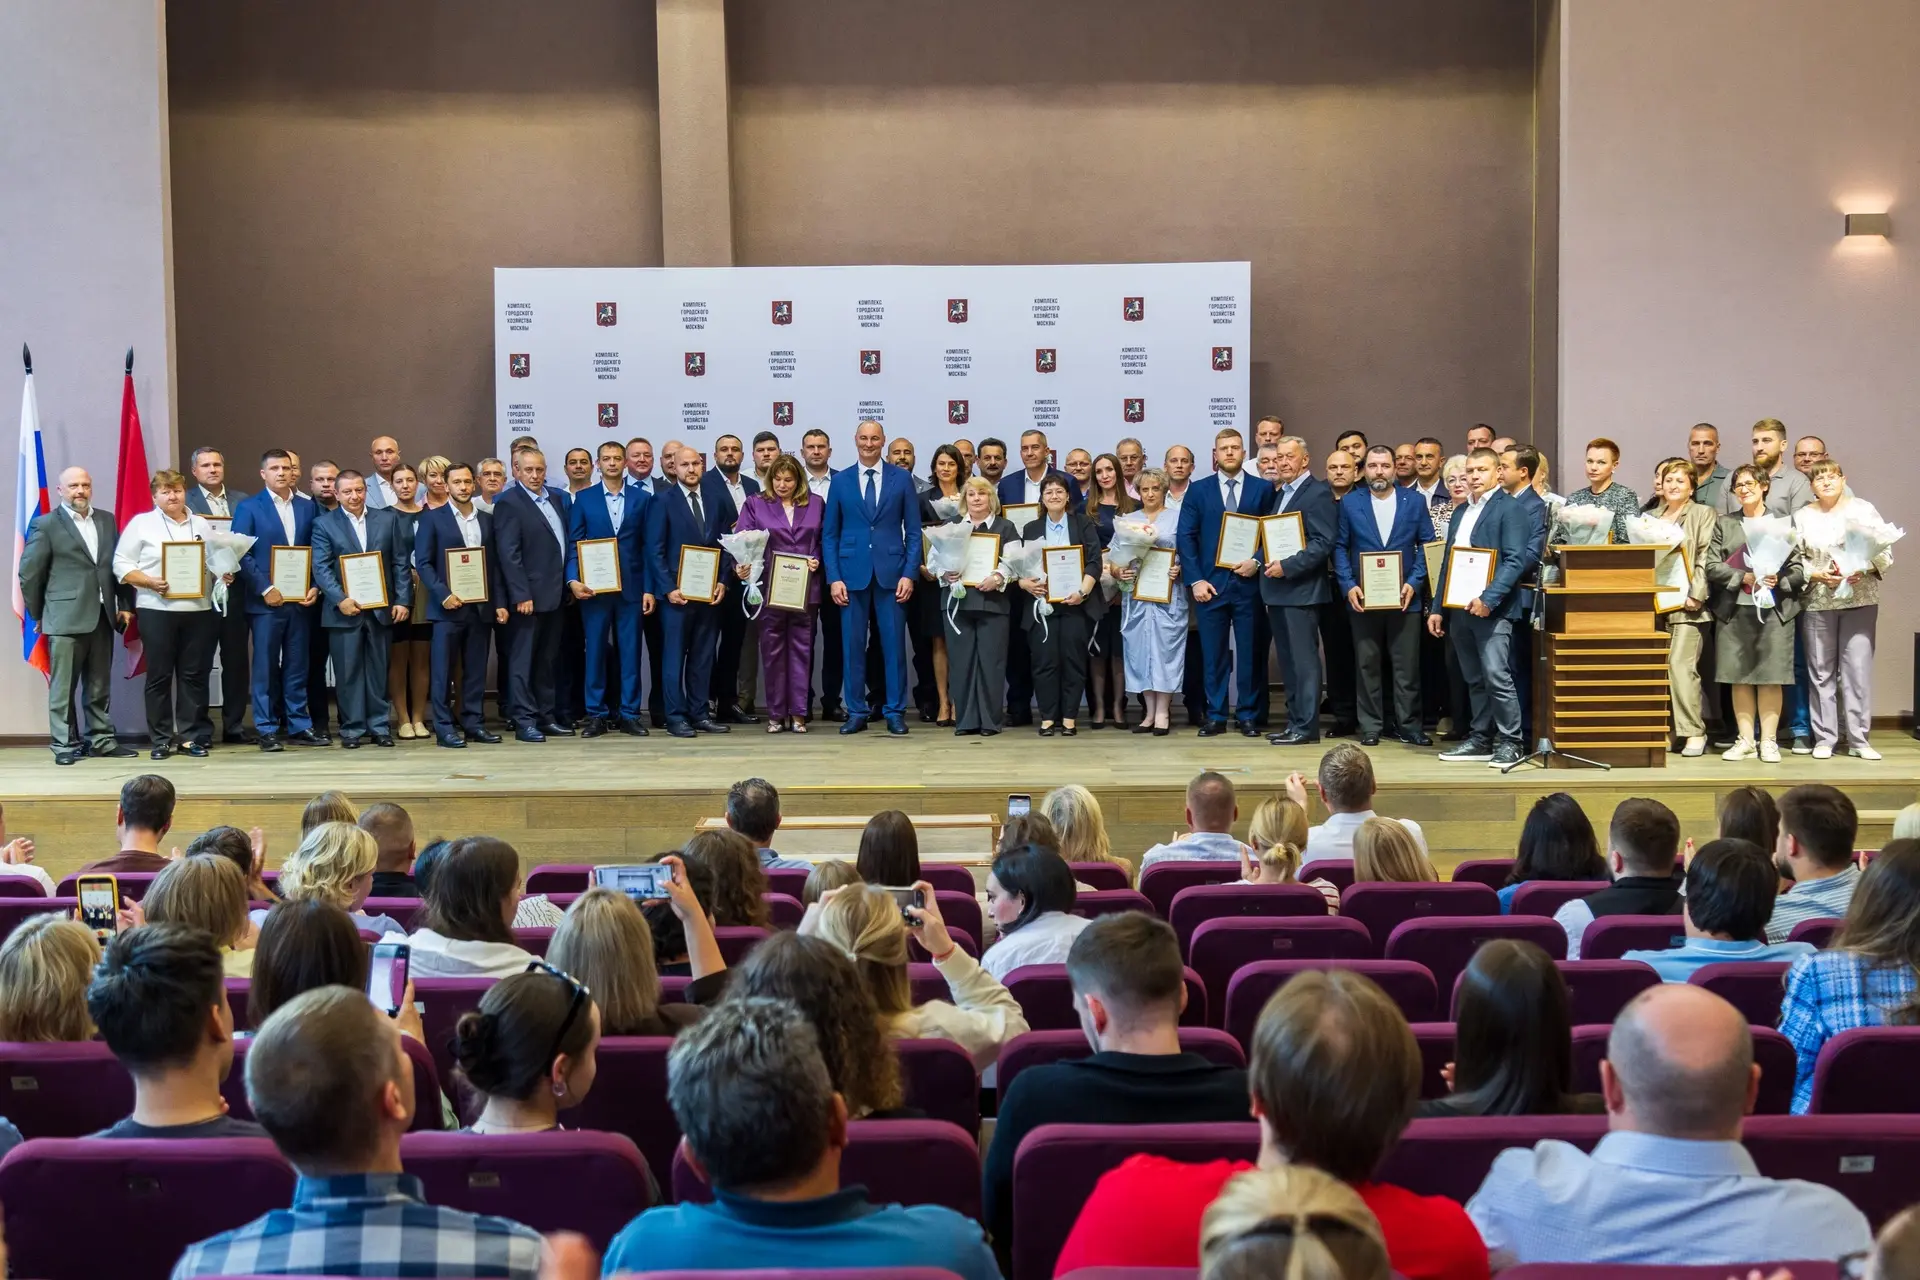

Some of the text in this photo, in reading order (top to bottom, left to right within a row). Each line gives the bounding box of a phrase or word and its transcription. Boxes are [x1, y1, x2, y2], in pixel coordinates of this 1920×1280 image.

[680, 308, 710, 316] ГОРОДСКОГО
[855, 306, 885, 314] ГОРОДСКОГО
[943, 355, 973, 363] ГОРОДСКОГО
